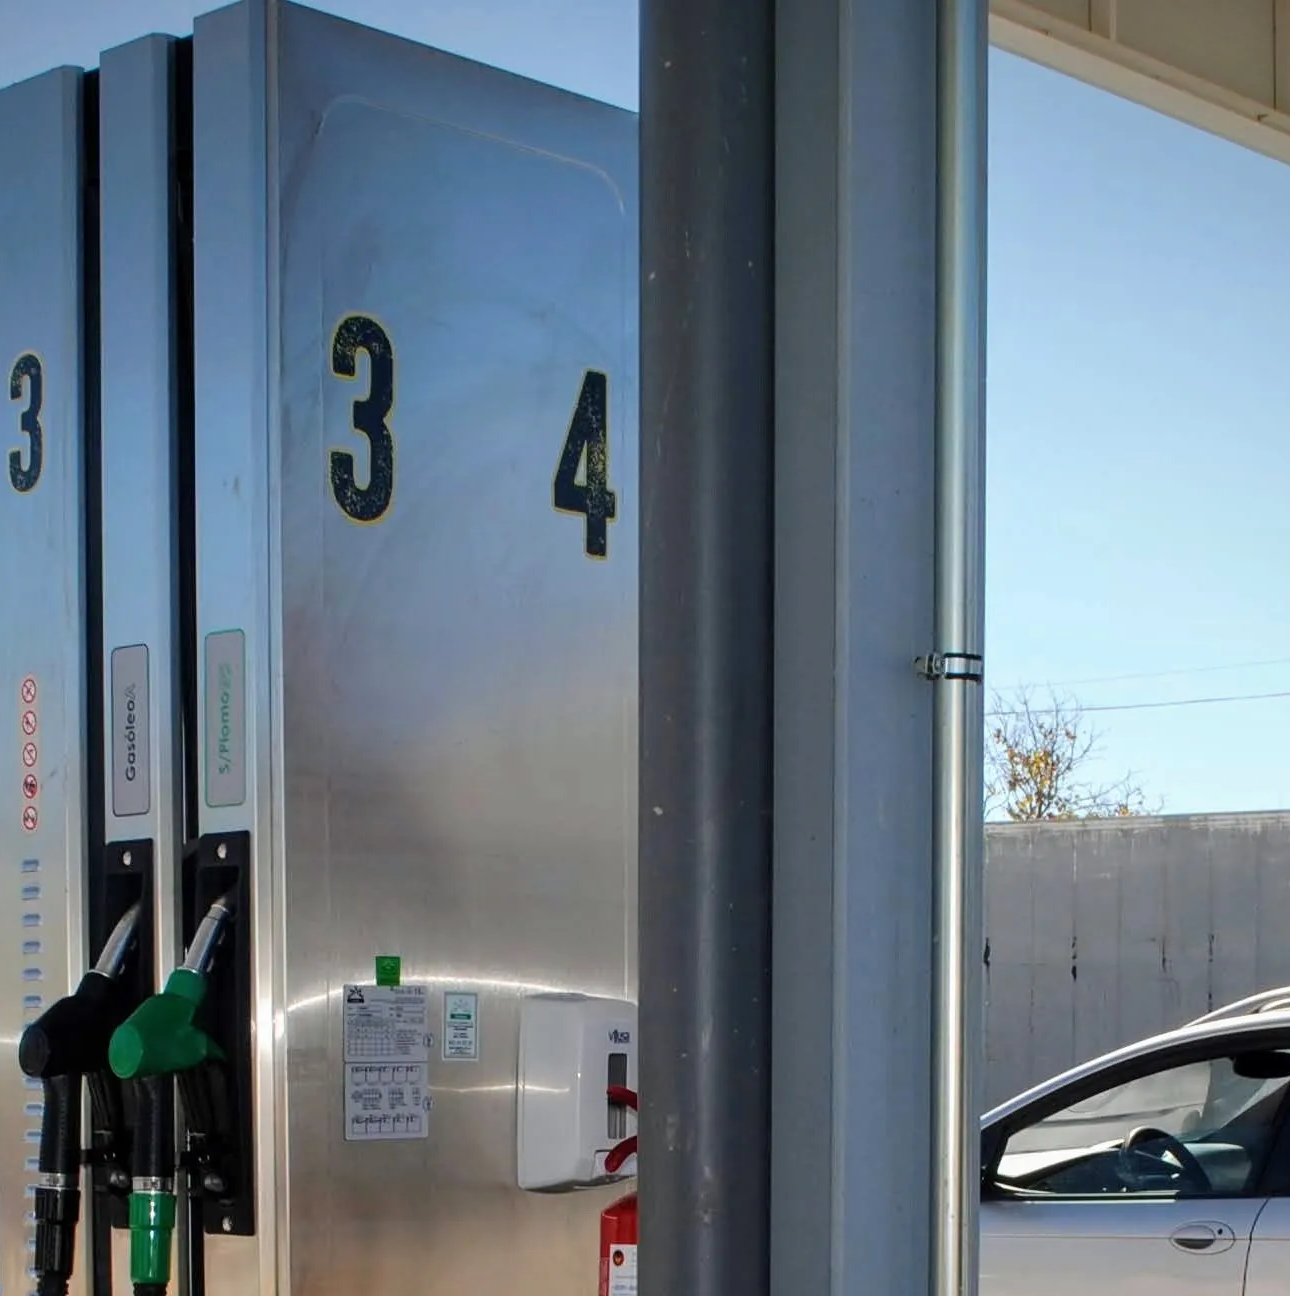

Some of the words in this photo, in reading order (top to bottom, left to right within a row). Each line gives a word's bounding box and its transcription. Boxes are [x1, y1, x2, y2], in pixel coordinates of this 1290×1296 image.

[8, 351, 45, 493] 3
[328, 313, 398, 525] 3
[552, 368, 618, 561] 4
